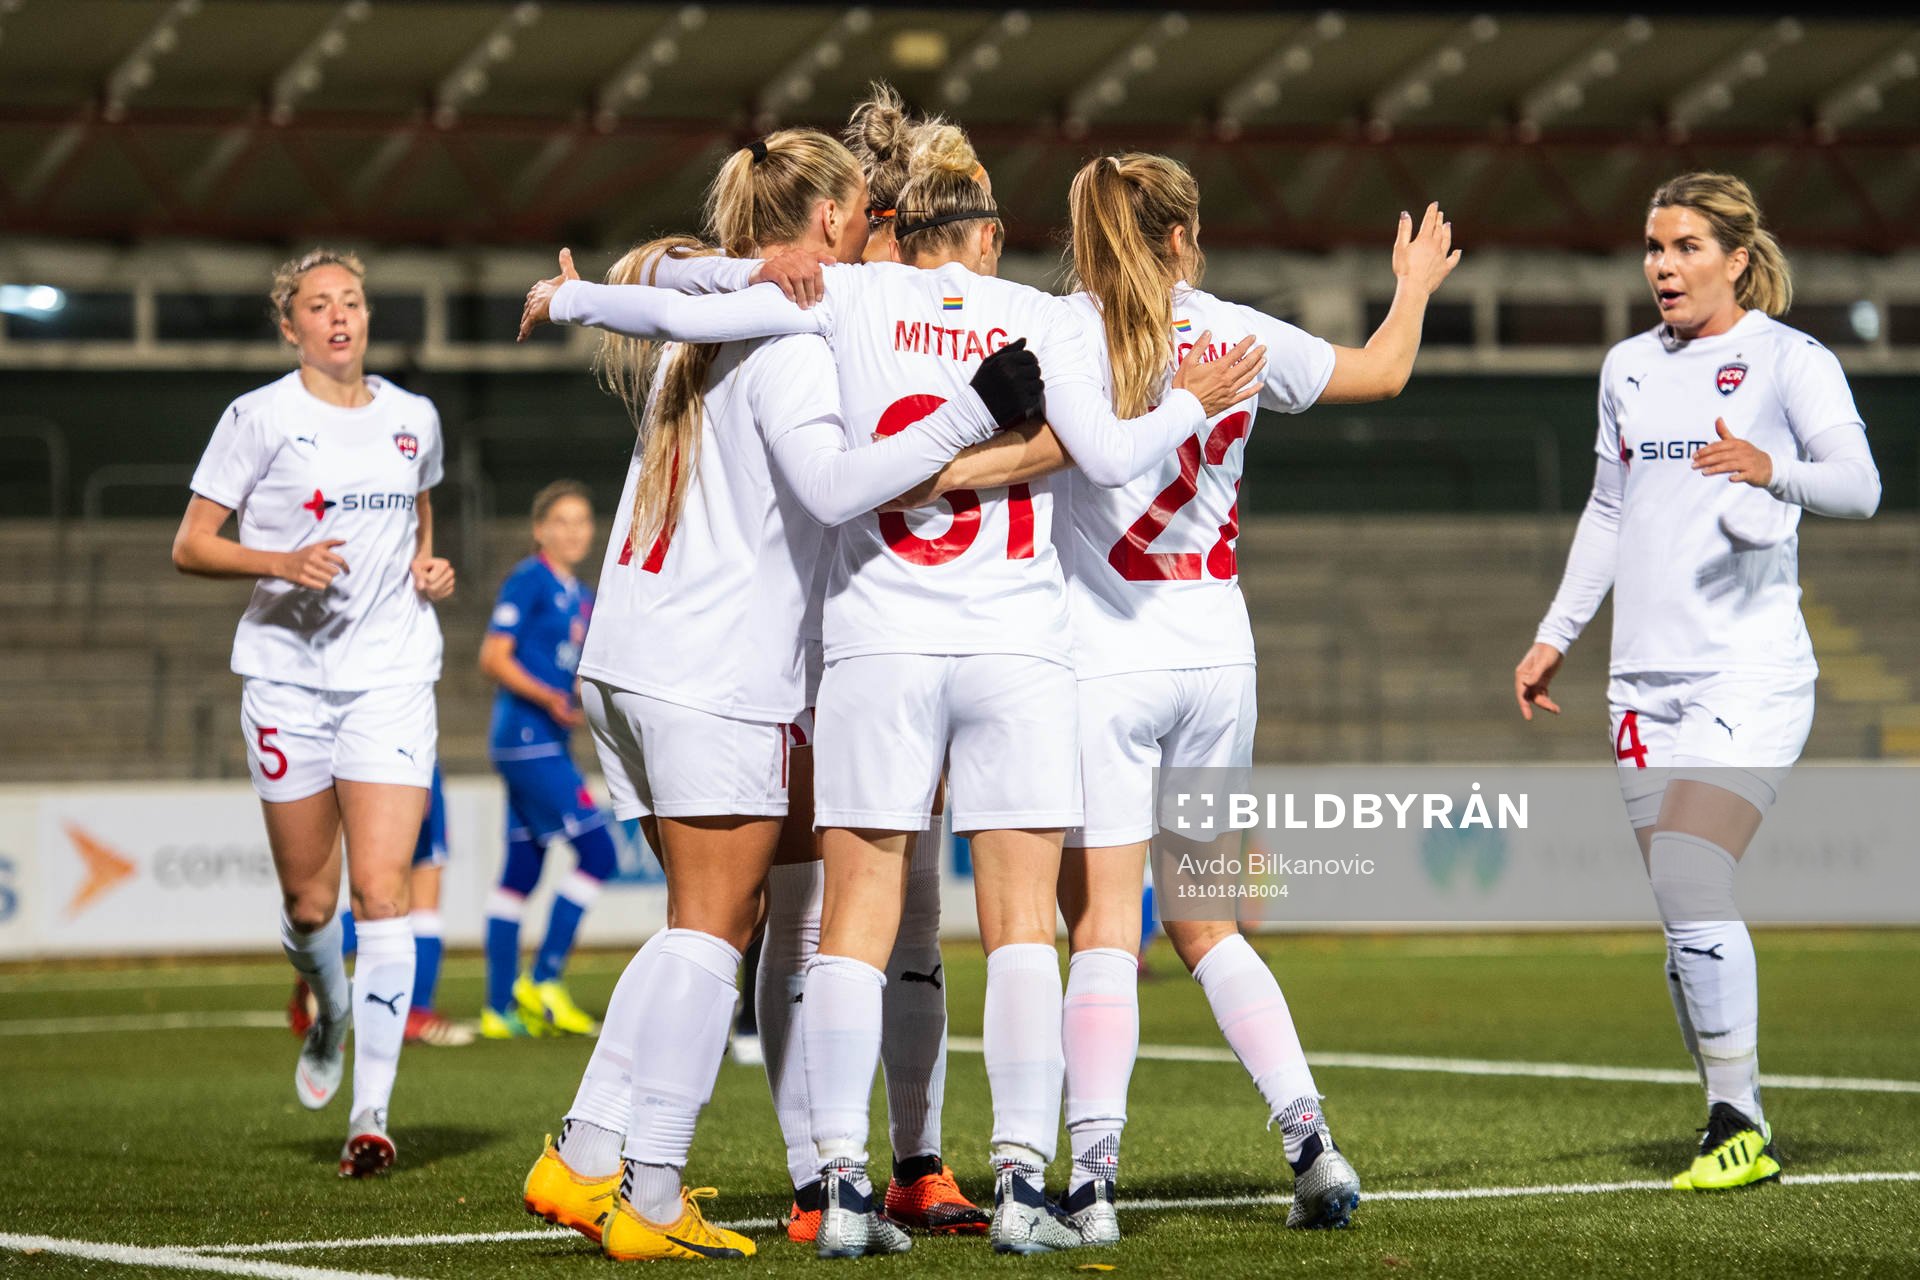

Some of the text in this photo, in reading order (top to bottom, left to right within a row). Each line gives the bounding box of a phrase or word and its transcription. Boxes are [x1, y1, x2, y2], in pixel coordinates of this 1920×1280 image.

[895, 320, 1009, 361] MITTAG
[1640, 440, 1708, 460] SIGM
[257, 727, 288, 780] 5
[1616, 709, 1649, 770] 4
